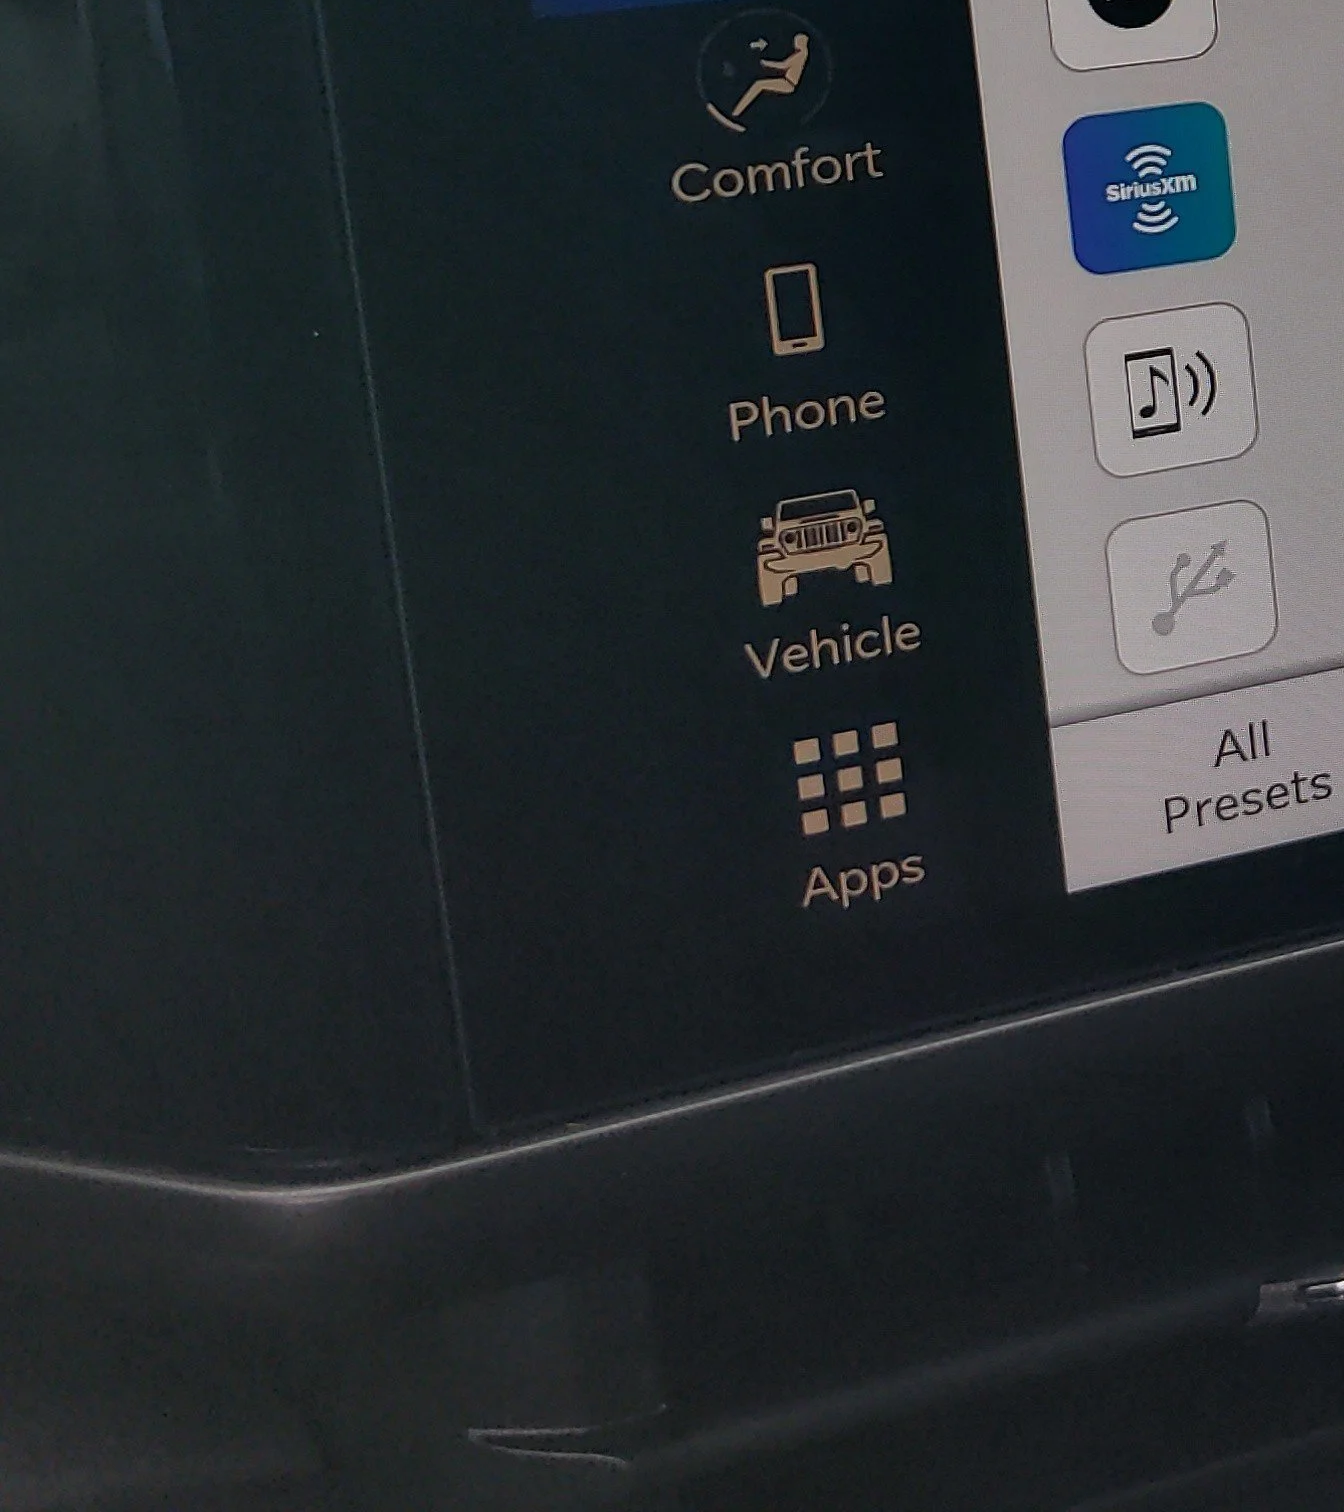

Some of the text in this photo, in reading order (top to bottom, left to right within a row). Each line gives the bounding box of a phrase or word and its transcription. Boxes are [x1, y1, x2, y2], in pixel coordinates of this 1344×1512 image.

[671, 141, 884, 203] Comfort
[728, 388, 887, 442] Phone
[744, 616, 922, 679] Vehicle
[1213, 718, 1272, 768] All
[1164, 769, 1335, 835] Presets
[802, 851, 926, 909] Apps
